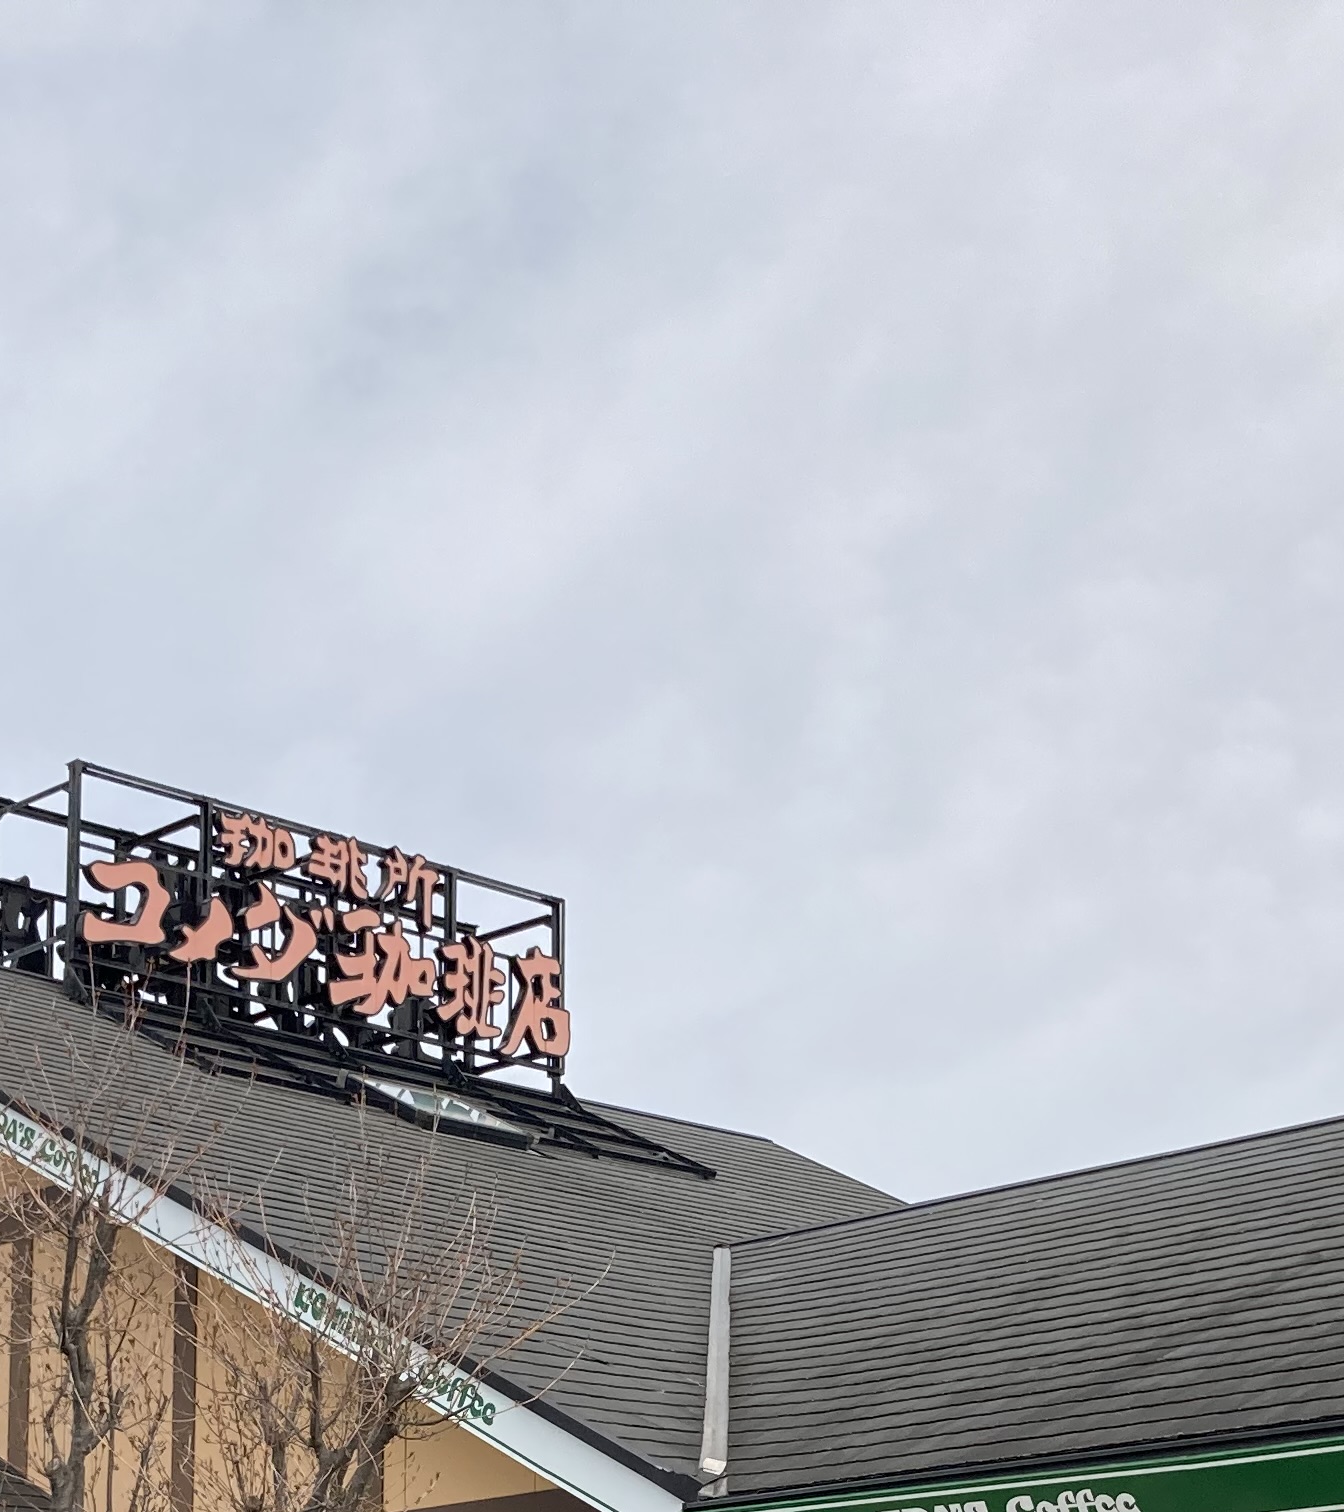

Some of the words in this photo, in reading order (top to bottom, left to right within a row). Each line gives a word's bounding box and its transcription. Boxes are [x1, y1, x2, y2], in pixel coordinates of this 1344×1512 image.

[80, 860, 572, 1057] コメダ珈琲店
